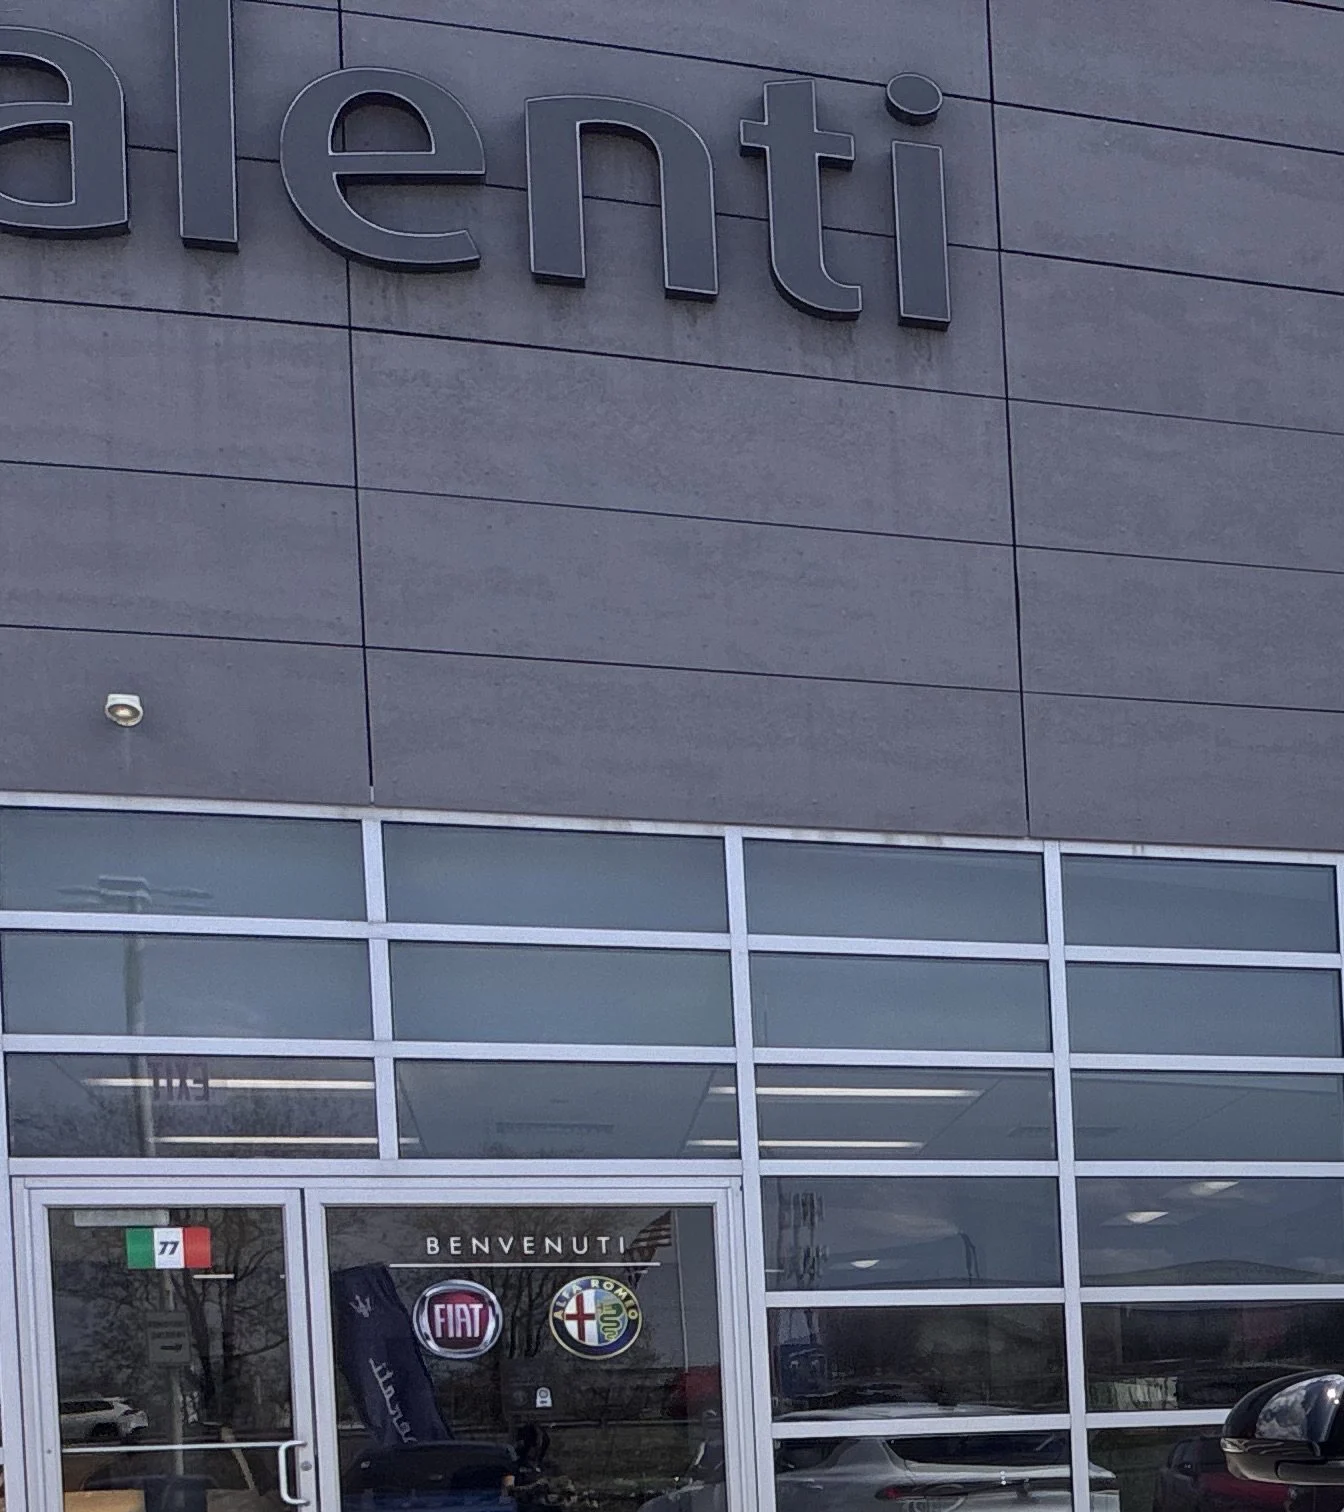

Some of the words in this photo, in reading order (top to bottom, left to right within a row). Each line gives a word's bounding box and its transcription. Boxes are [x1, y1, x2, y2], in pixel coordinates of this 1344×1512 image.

[158, 1241, 180, 1255] 77
[426, 1236, 625, 1255] BENVENUTI
[553, 1283, 584, 1319] ALFA
[591, 1279, 639, 1320] ROMEO
[434, 1303, 484, 1338] FIAT
